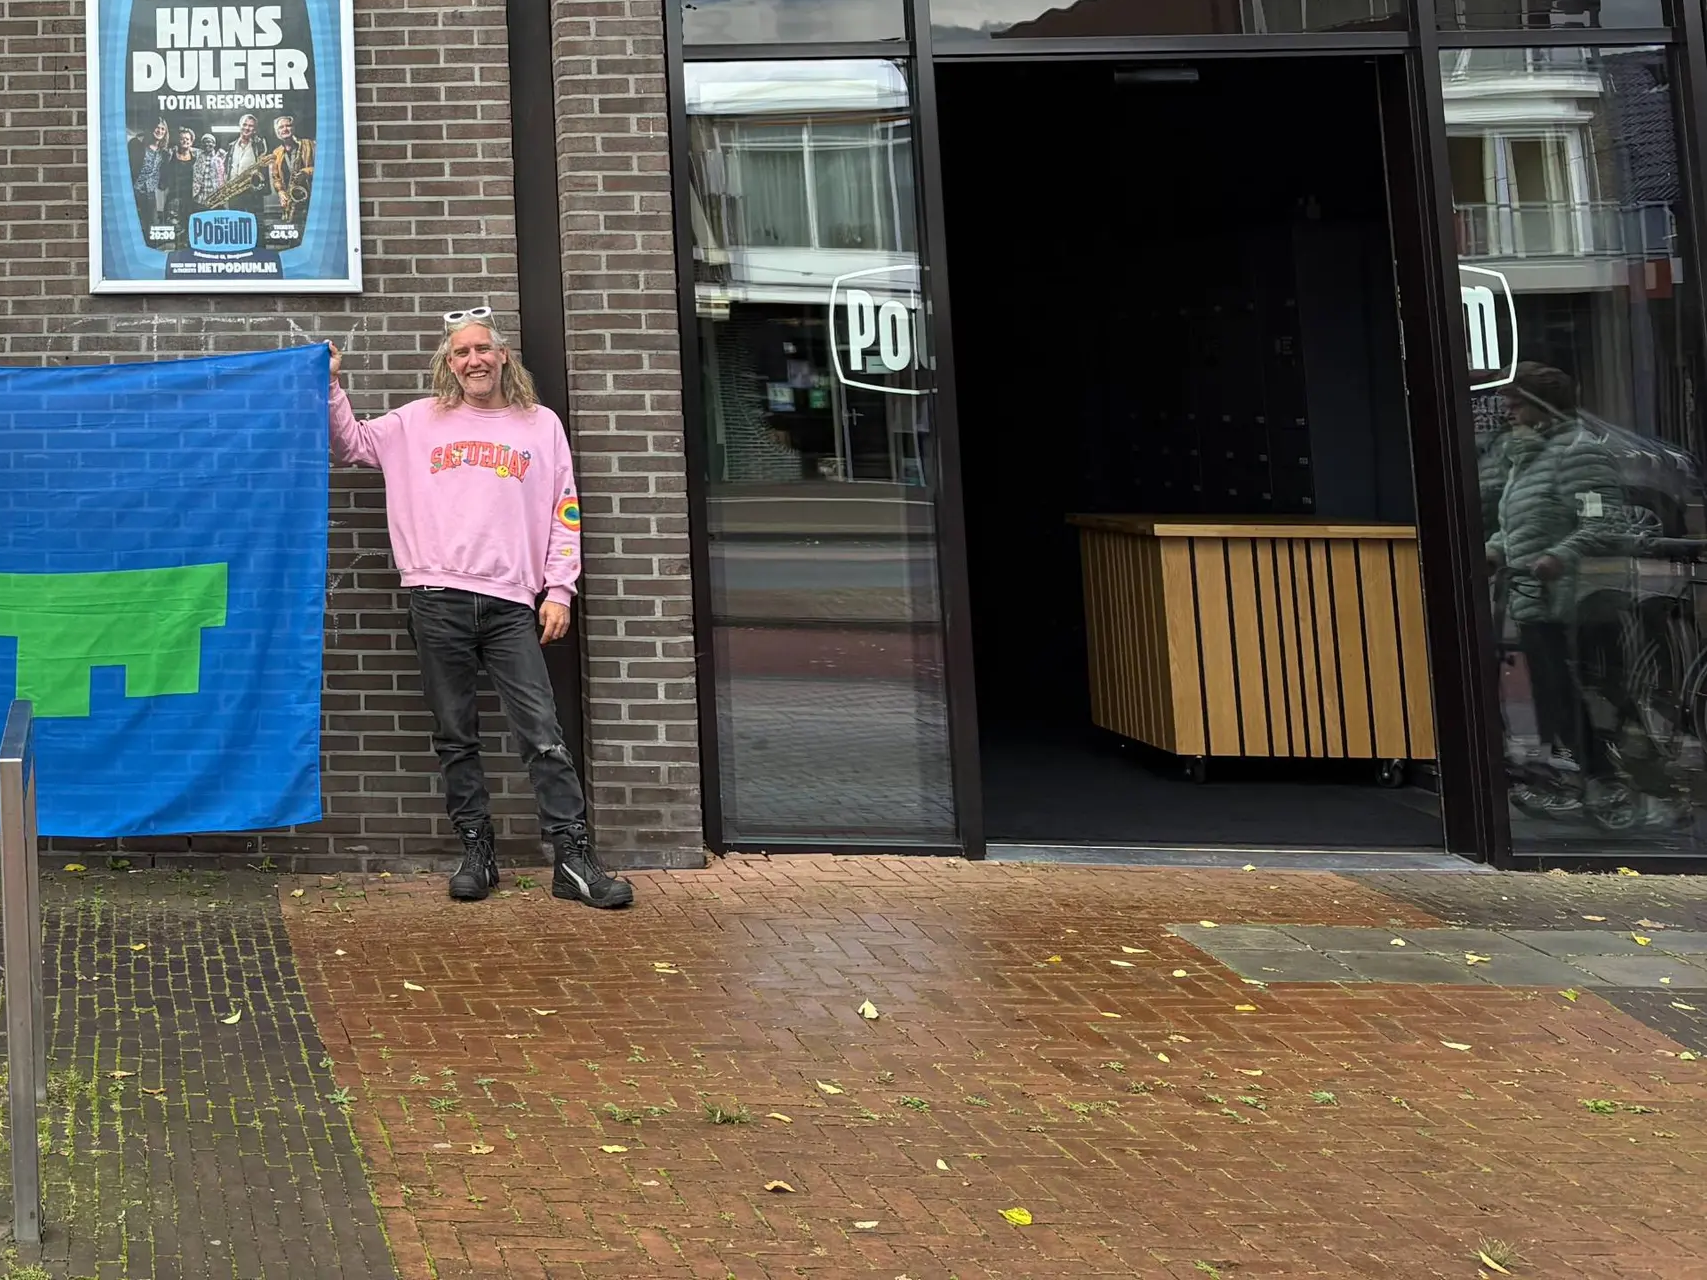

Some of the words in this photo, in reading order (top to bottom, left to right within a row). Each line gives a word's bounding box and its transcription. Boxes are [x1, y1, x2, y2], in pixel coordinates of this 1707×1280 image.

[156, 6, 283, 48] HANS
[132, 49, 310, 92] DULFER
[158, 95, 203, 110] TOTAL
[206, 94, 284, 110] RESPONSE
[150, 230, 176, 240] 20:00
